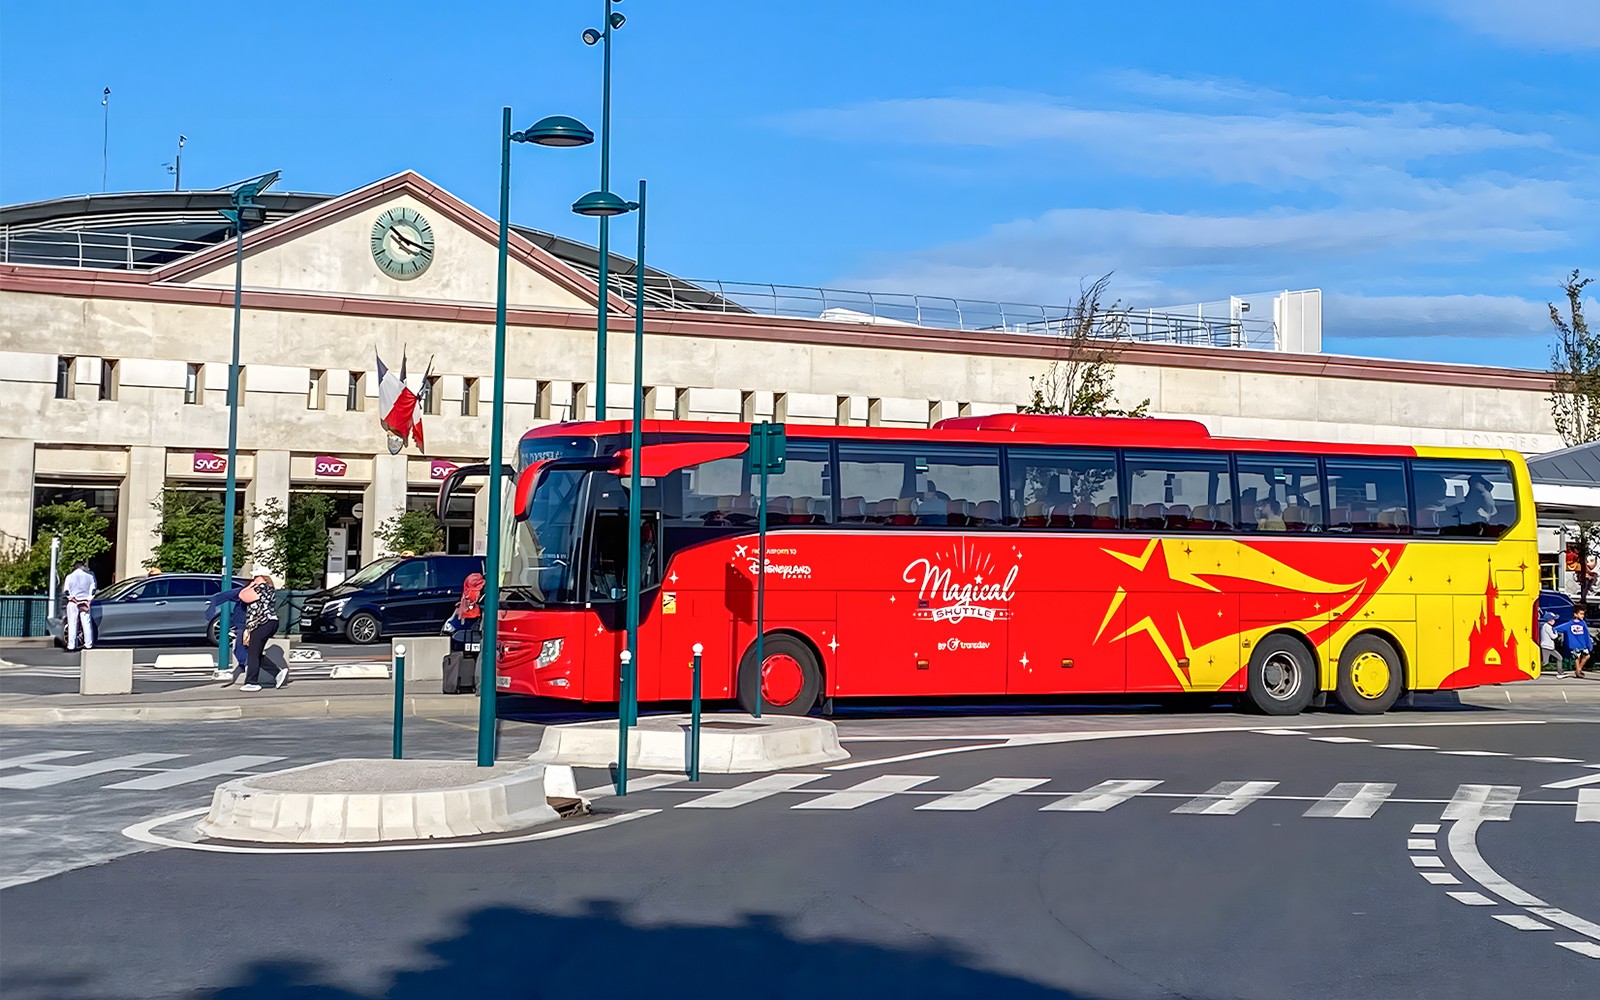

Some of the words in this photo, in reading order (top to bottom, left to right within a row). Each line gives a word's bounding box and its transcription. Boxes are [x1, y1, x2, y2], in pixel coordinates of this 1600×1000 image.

[194, 459, 226, 470] SNCF
[316, 462, 346, 473] SNCF
[431, 466, 457, 477] SN
[902, 558, 1019, 624] Magical
[936, 606, 992, 618] SHUTTLE
